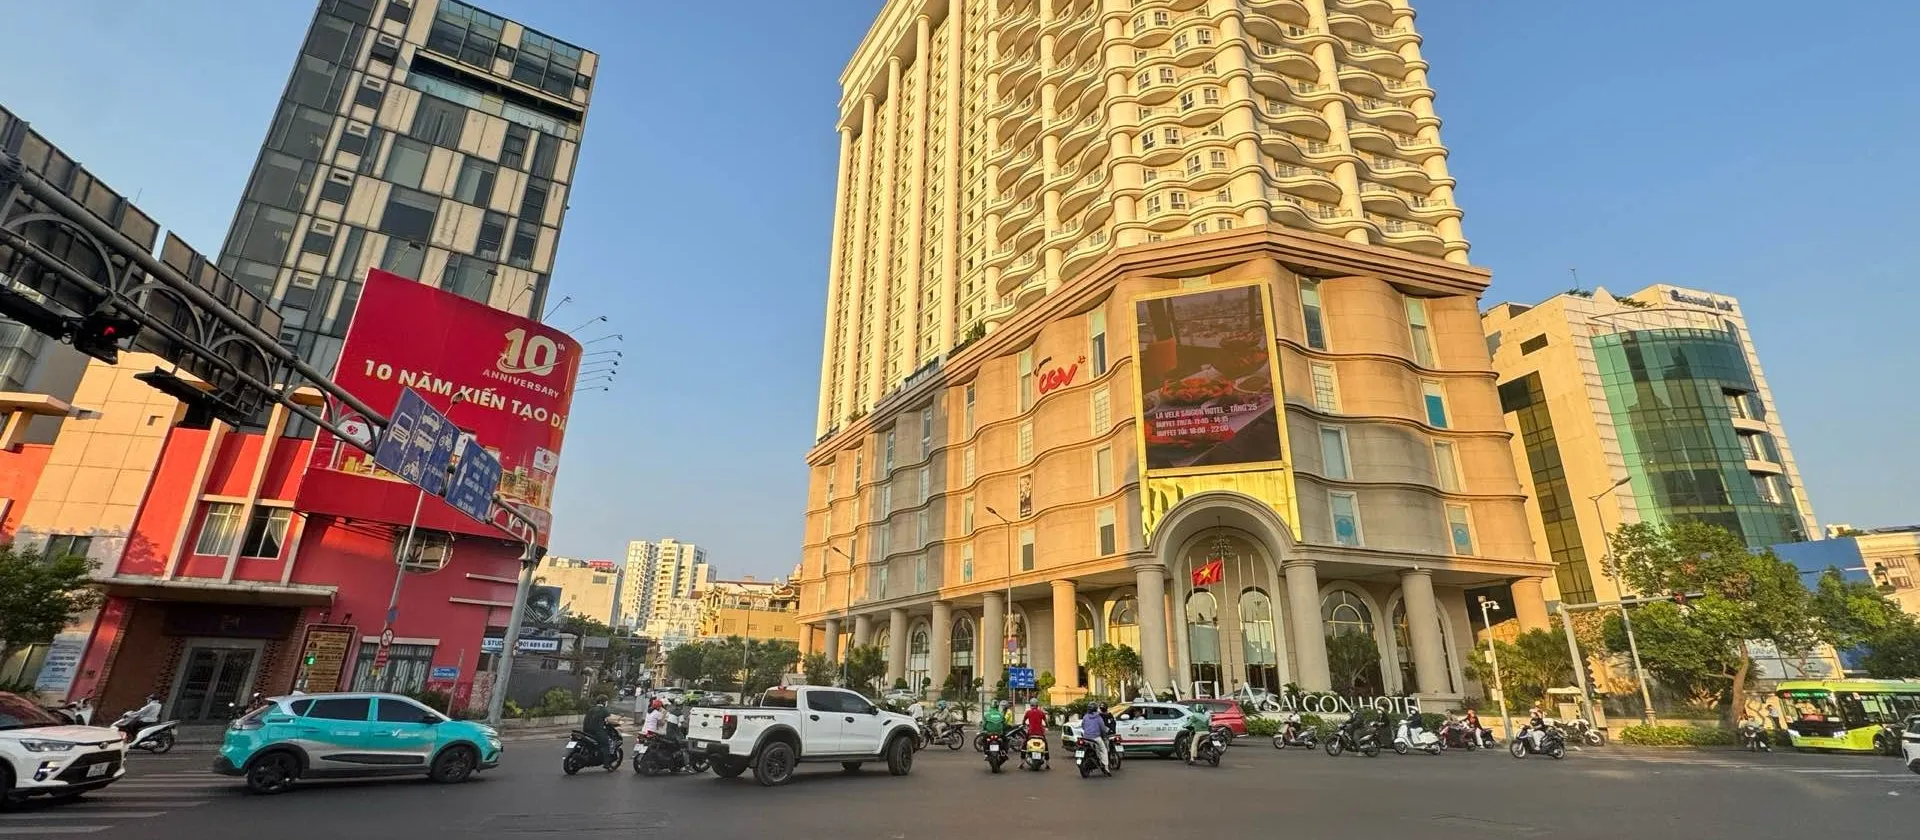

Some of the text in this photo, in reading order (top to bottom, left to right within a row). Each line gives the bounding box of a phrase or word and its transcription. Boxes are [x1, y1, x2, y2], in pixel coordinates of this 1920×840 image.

[365, 358, 393, 381] 10
[398, 369, 453, 396] NĂM
[460, 385, 506, 411] KIẾN
[511, 399, 548, 421] TẠO
[482, 368, 559, 399] ANNIVERSARY
[1039, 363, 1078, 394] CGV
[1155, 411, 1164, 420] LA
[1165, 410, 1180, 419] VELA
[1204, 406, 1224, 415] HOTEL
[1120, 679, 1260, 712] LA VELA
[1266, 694, 1422, 714] SAIGON HOTEL
